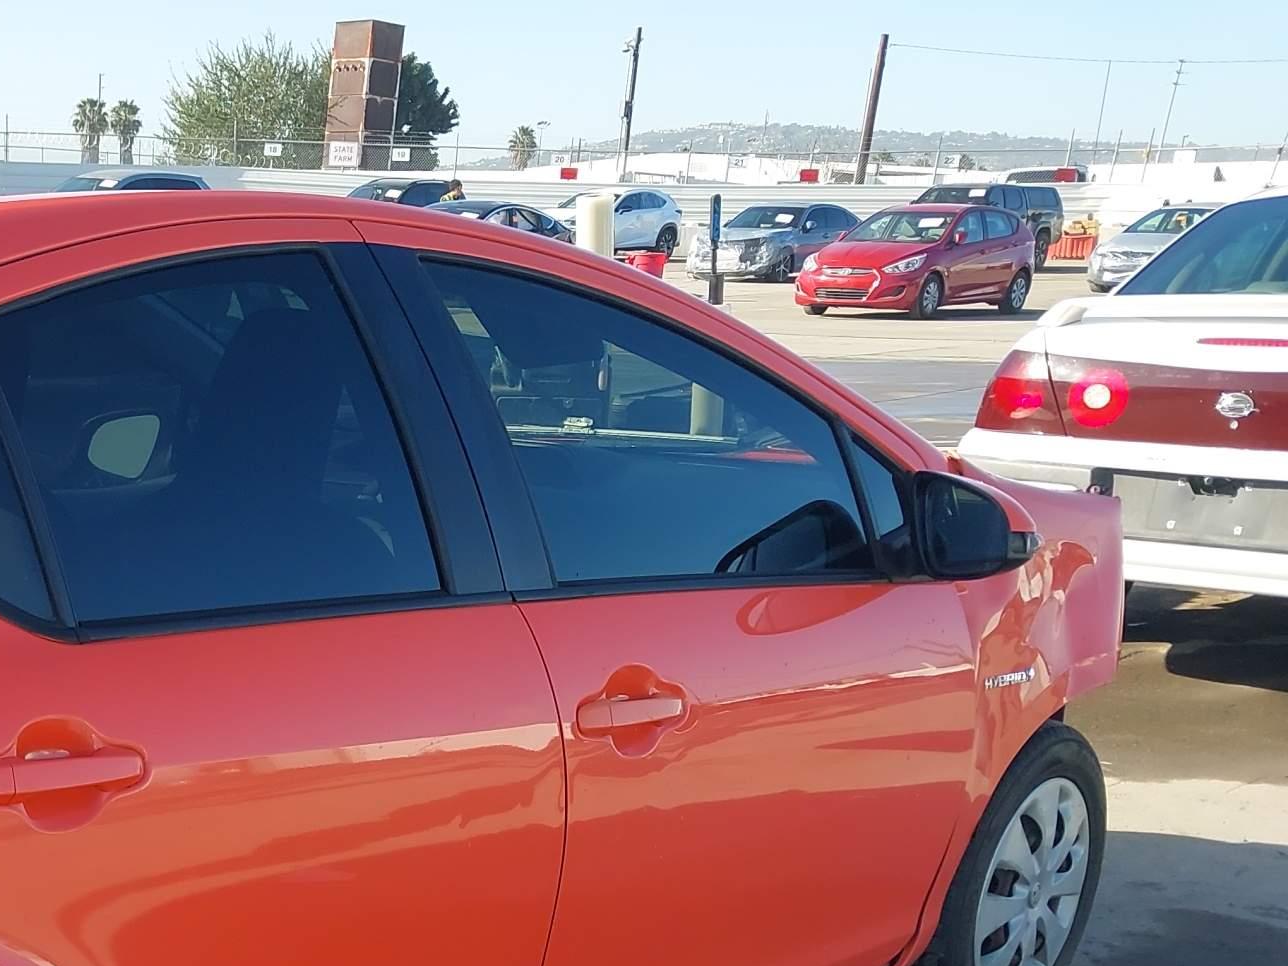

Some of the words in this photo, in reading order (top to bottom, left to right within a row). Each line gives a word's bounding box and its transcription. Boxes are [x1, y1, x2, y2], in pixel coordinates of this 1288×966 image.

[334, 146, 353, 154] STATE
[735, 158, 744, 167] 21
[984, 671, 1027, 690] HYBRID
